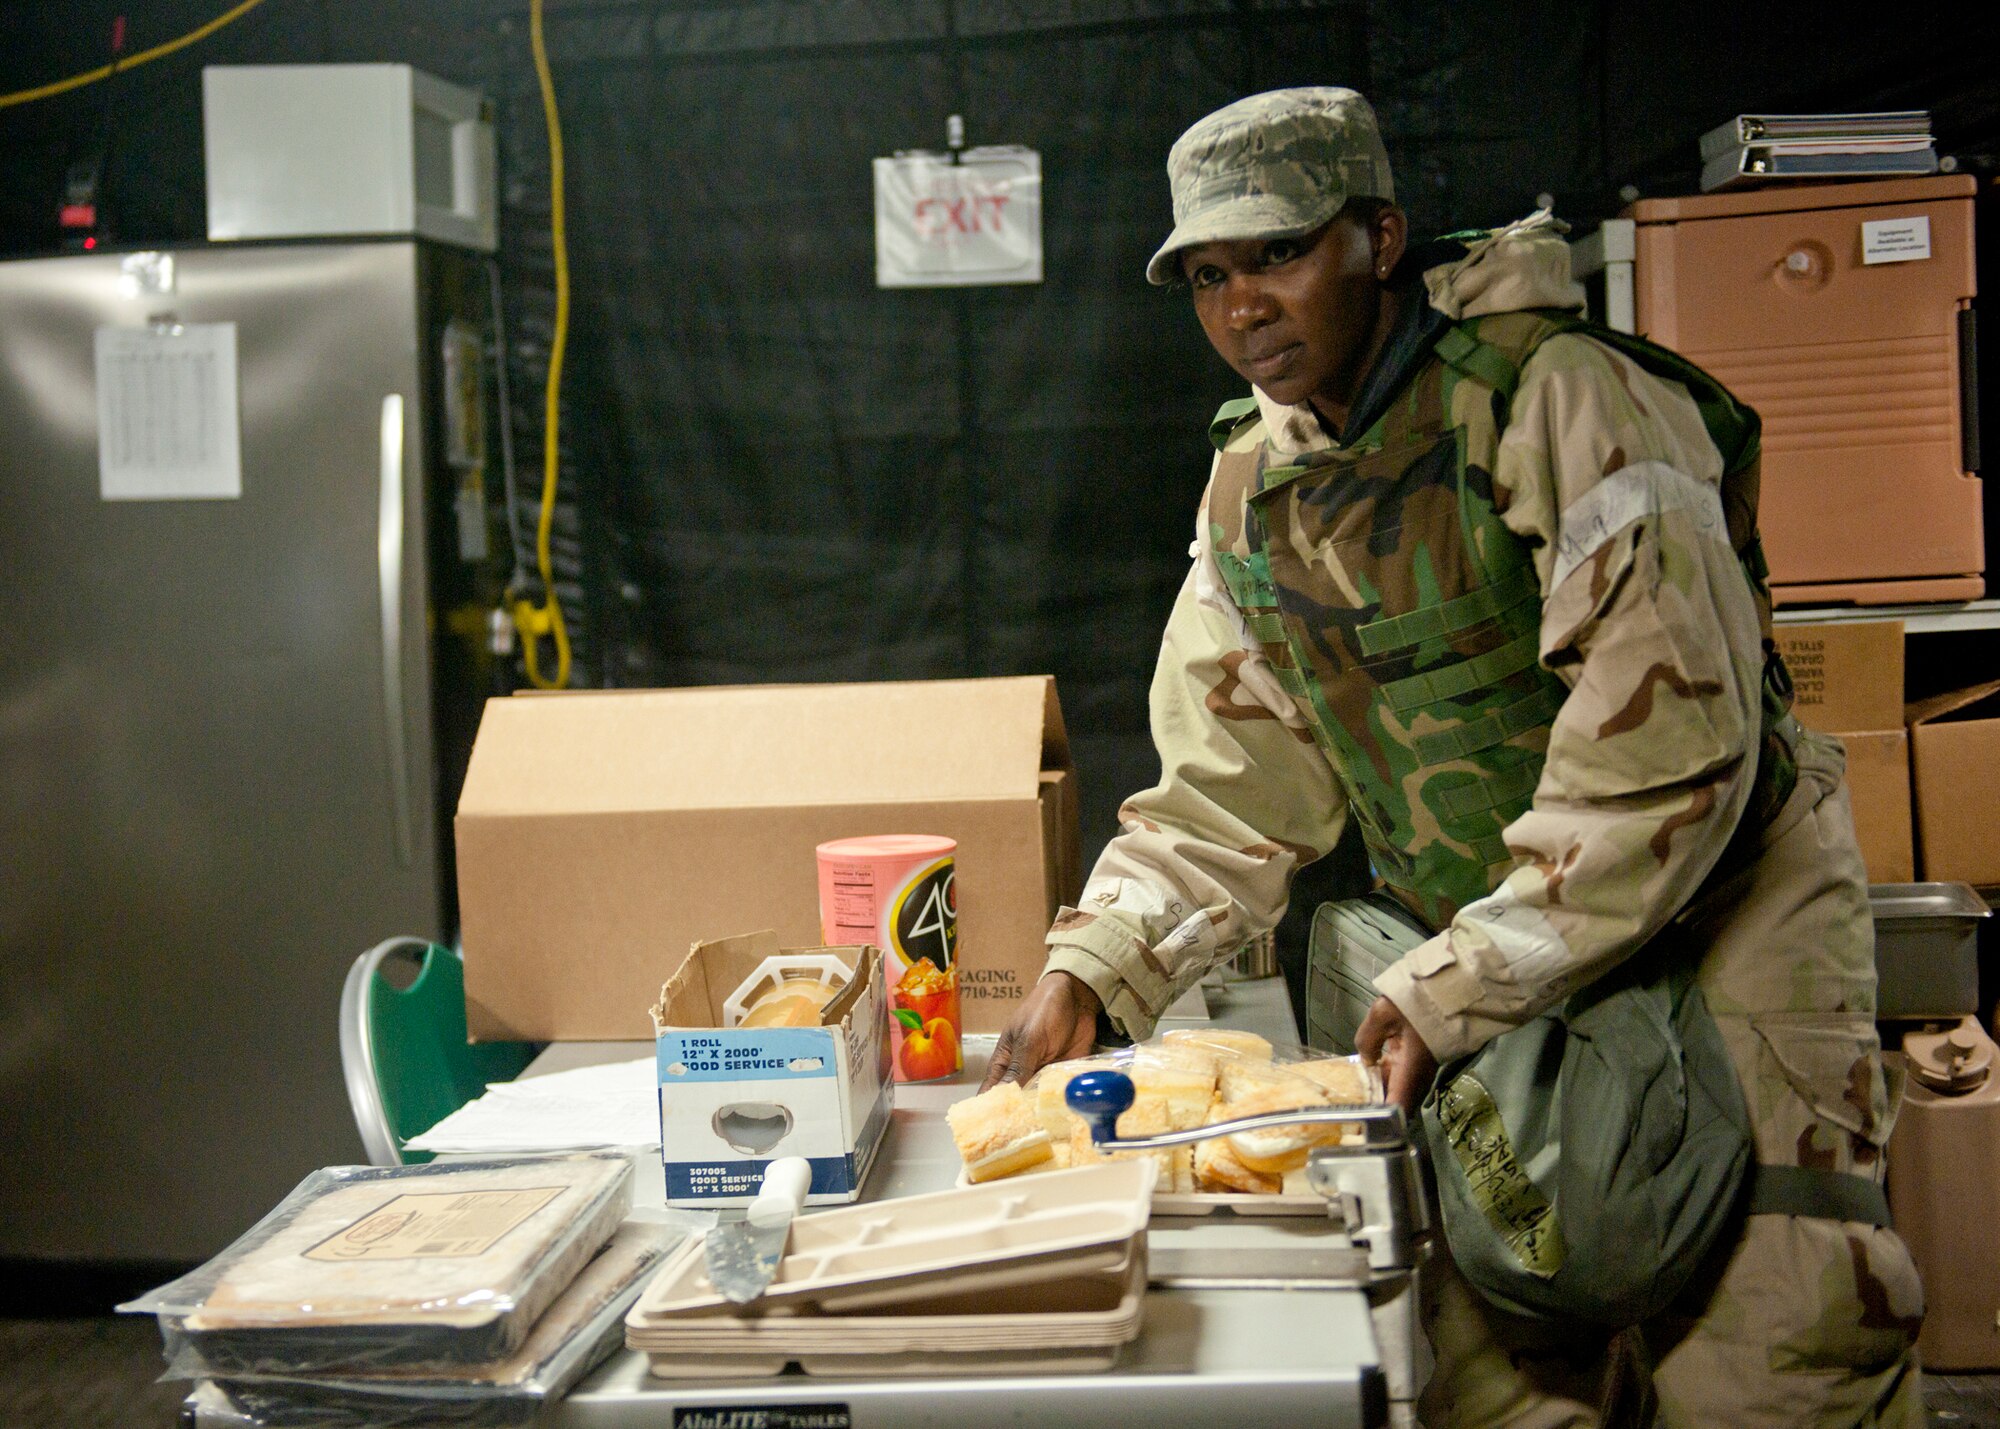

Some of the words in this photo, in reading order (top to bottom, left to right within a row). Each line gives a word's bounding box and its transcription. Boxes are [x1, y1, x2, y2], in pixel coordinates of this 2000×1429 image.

[691, 1039, 722, 1047] ROLL
[682, 1049, 704, 1059] 12"
[710, 1050, 719, 1059] X
[725, 1048, 763, 1059] 2000'
[725, 1058, 785, 1071] SERVICE
[689, 1167, 727, 1176] 307005
[690, 1177, 718, 1185] FOOD
[720, 1174, 763, 1183] SERVICE
[711, 1185, 719, 1193] X
[722, 1184, 750, 1193] 2000'
